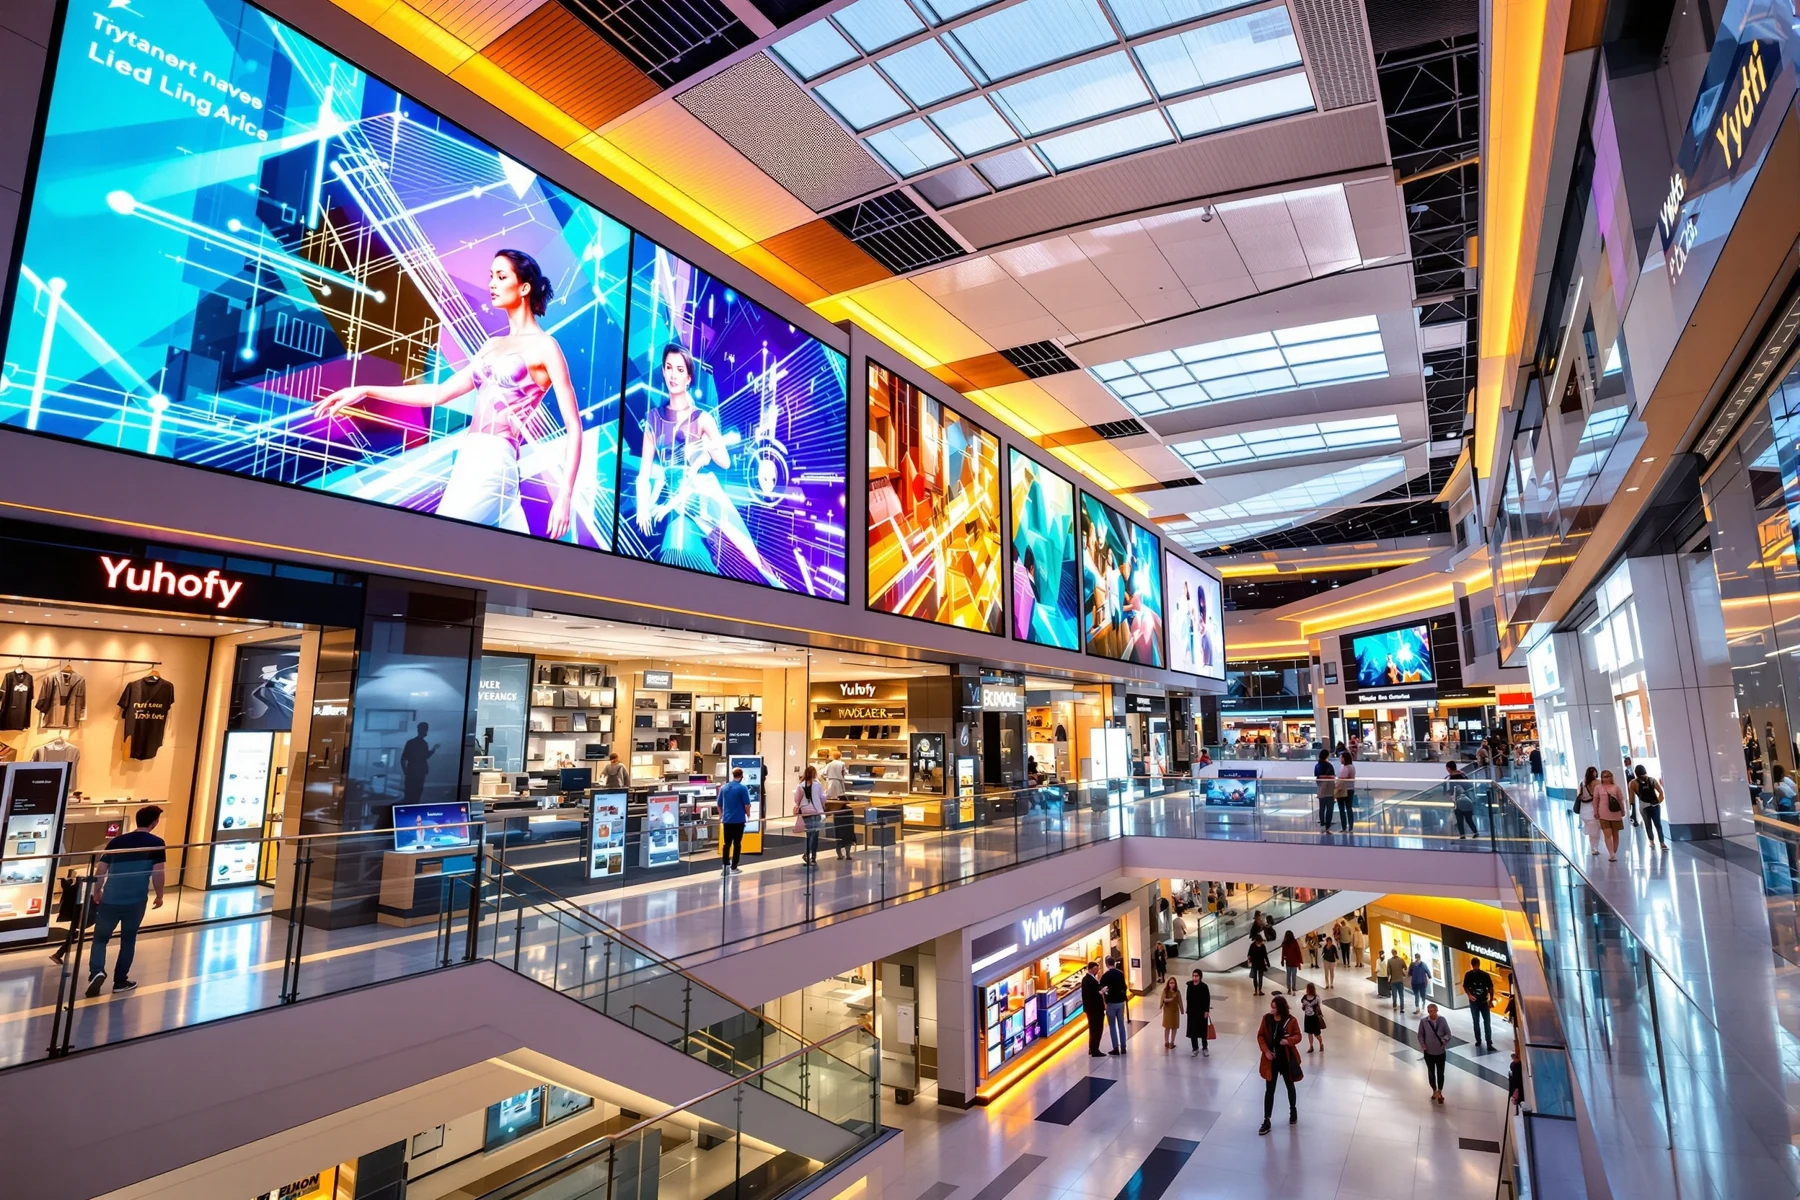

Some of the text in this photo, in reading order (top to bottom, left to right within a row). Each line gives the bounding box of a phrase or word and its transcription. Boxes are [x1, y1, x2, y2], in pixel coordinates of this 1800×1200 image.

[88, 41, 153, 86] Lied
[159, 75, 213, 117] Ling
[100, 556, 243, 609] Yuhofy
